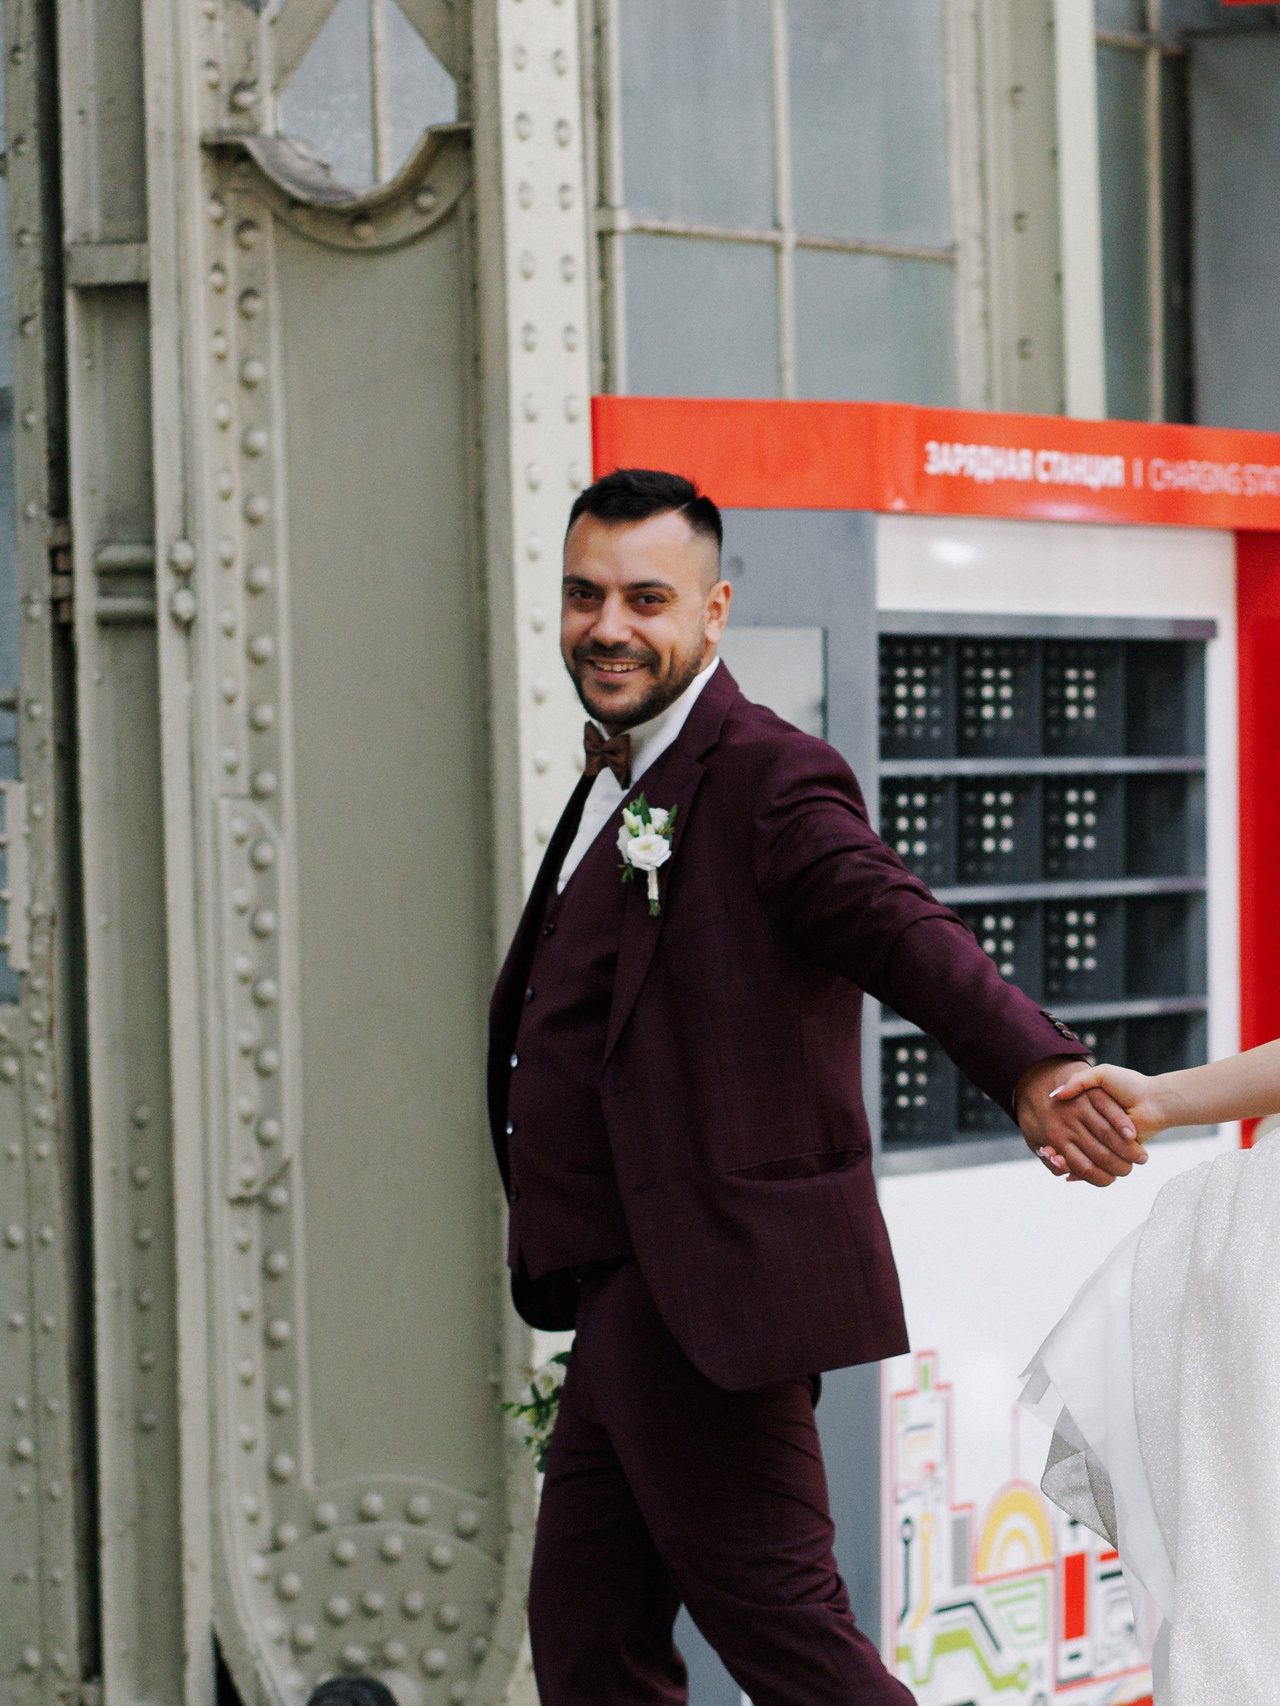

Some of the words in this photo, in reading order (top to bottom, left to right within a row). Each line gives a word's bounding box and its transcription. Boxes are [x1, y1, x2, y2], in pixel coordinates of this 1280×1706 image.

[925, 440, 1034, 484] ЗАРЯДНАЯ
[1034, 449, 1126, 492] СТАНЦИЯ
[1149, 457, 1241, 496] CHARGING
